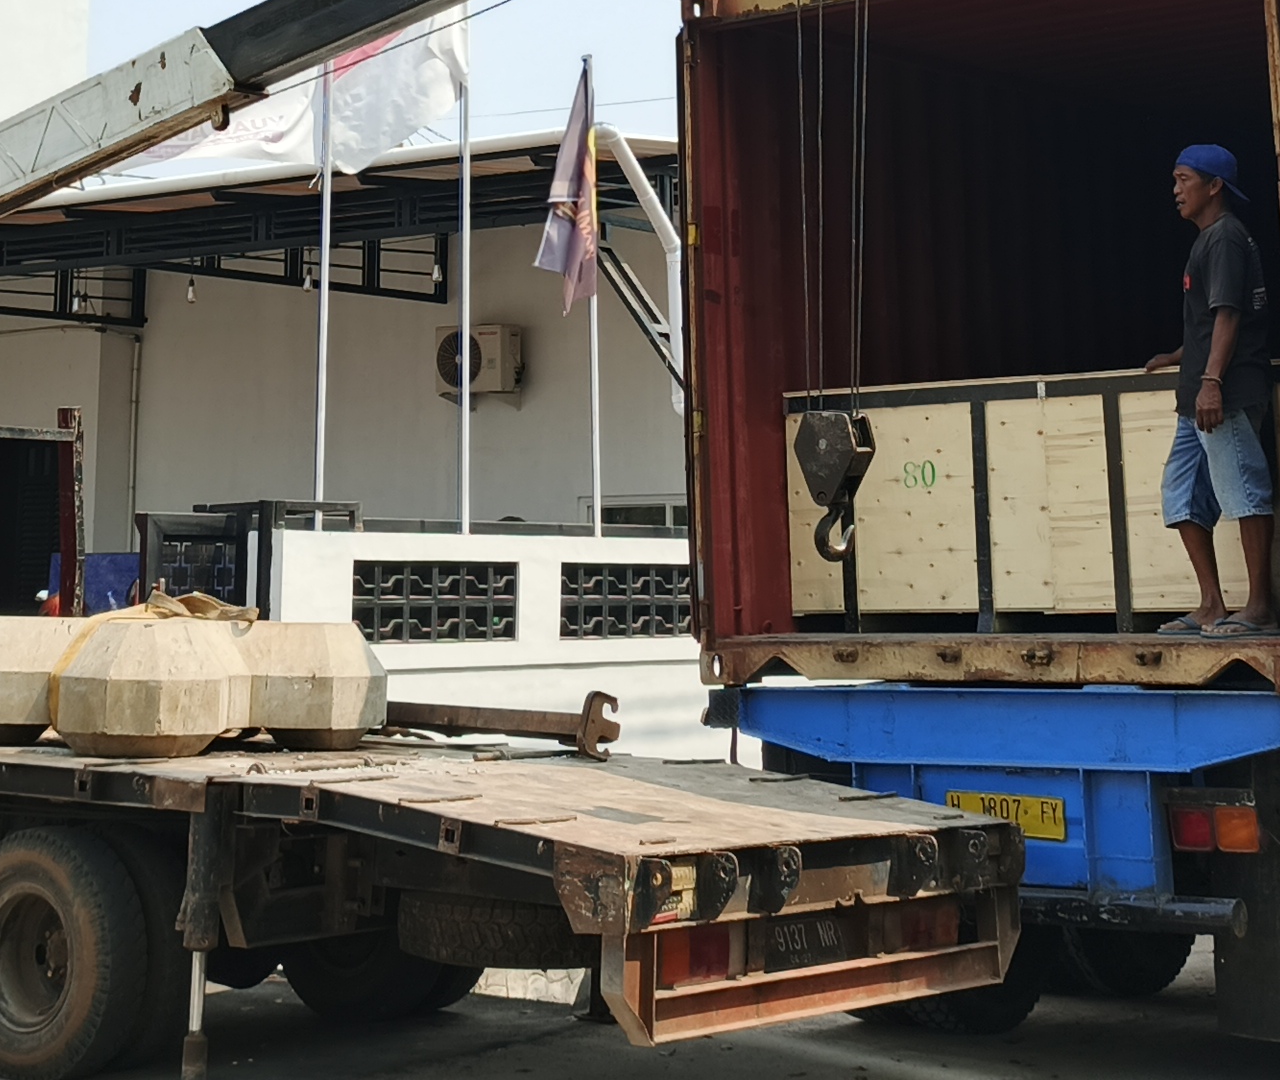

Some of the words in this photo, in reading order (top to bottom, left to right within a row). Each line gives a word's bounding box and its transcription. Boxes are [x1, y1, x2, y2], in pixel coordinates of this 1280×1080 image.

[904, 460, 936, 488] 80
[950, 794, 960, 809] H
[980, 797, 1021, 822] 1807
[1040, 801, 1058, 825] FY
[775, 924, 808, 952] 9137
[816, 920, 838, 947] NR
